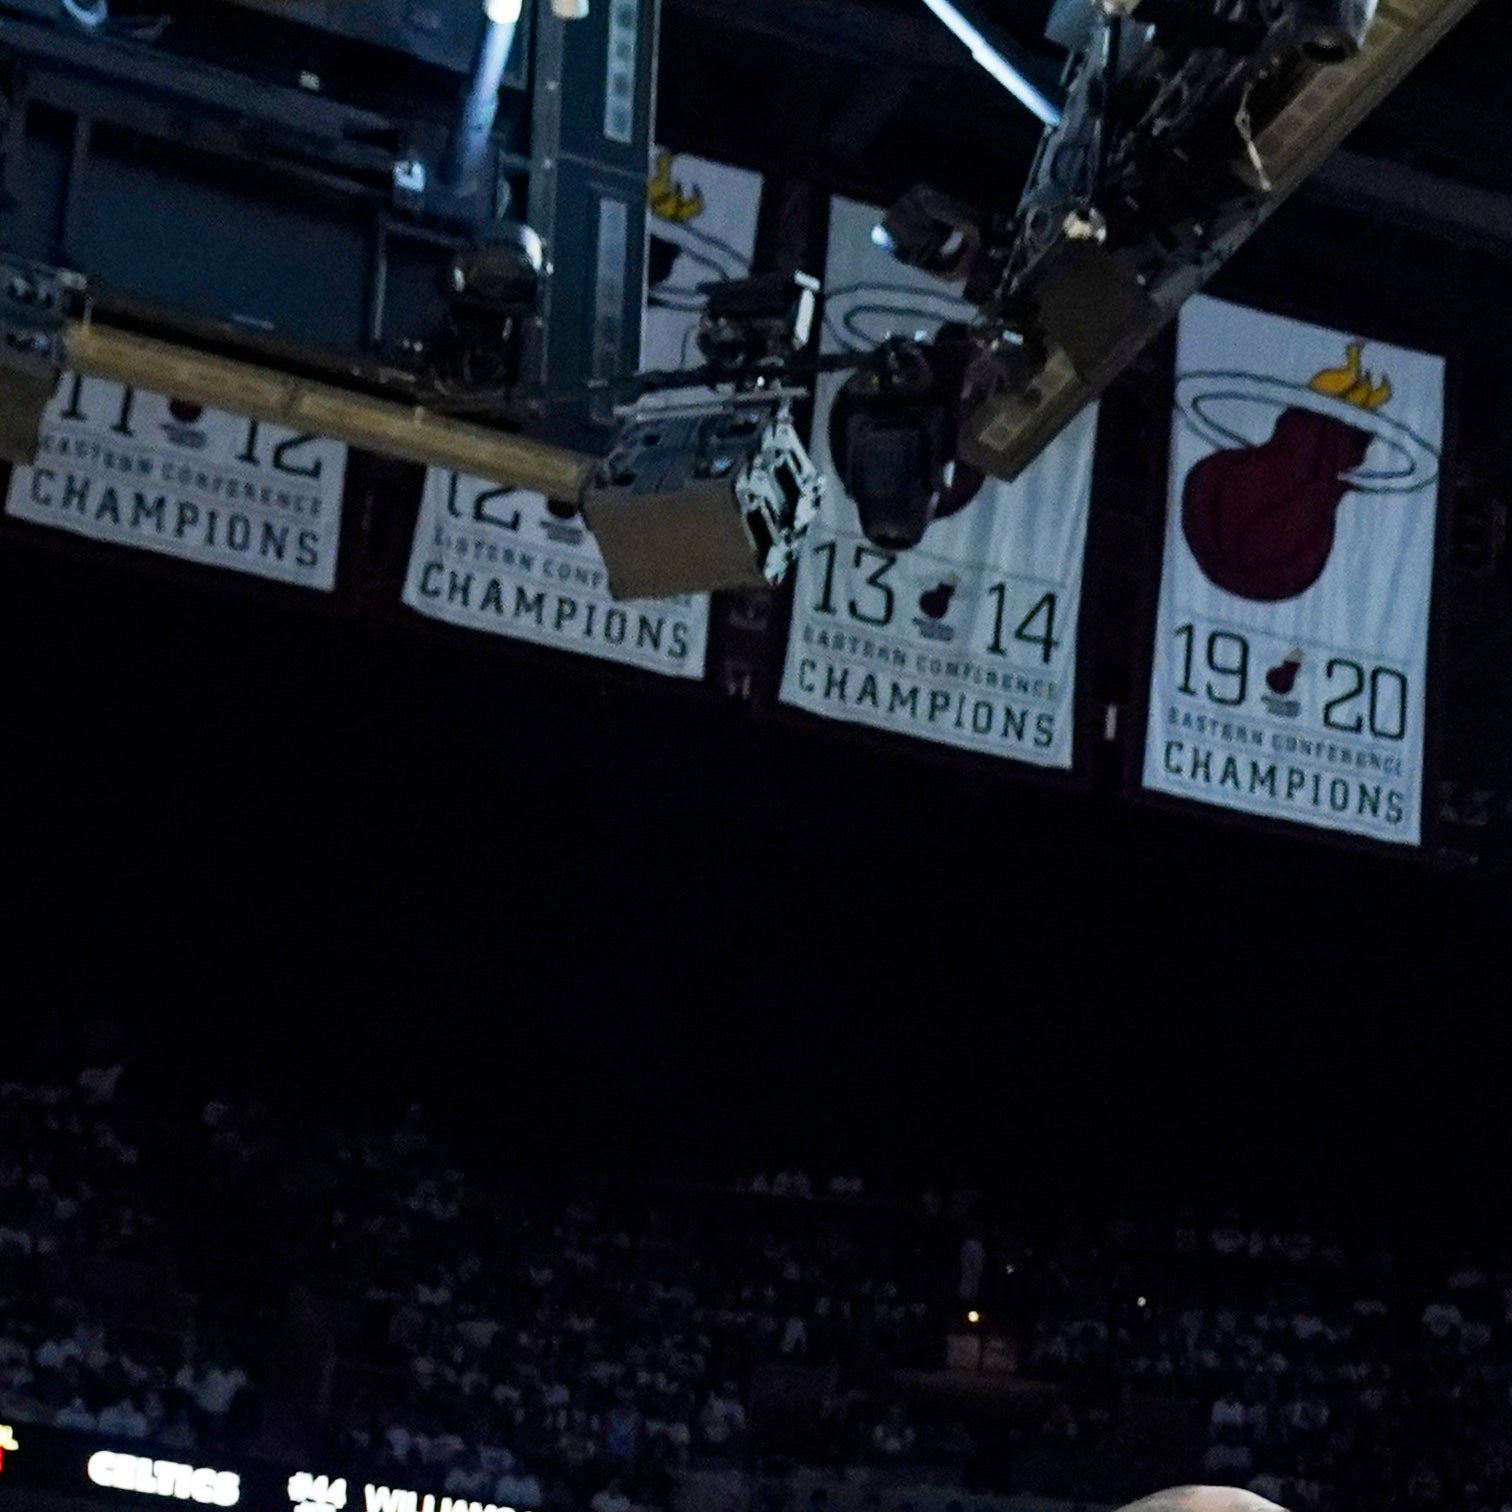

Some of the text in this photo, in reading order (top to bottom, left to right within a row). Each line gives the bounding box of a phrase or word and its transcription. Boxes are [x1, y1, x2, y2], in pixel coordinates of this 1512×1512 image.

[30, 467, 320, 568] CHAMPIONS
[418, 560, 690, 660] CHAMPIONS
[811, 540, 1061, 665] 13 14
[799, 658, 1056, 748] CHAMPIONS
[1173, 621, 1409, 742] 19 20
[1163, 740, 1403, 825] CHAMPIONS
[87, 1449, 242, 1508] CELTICS
